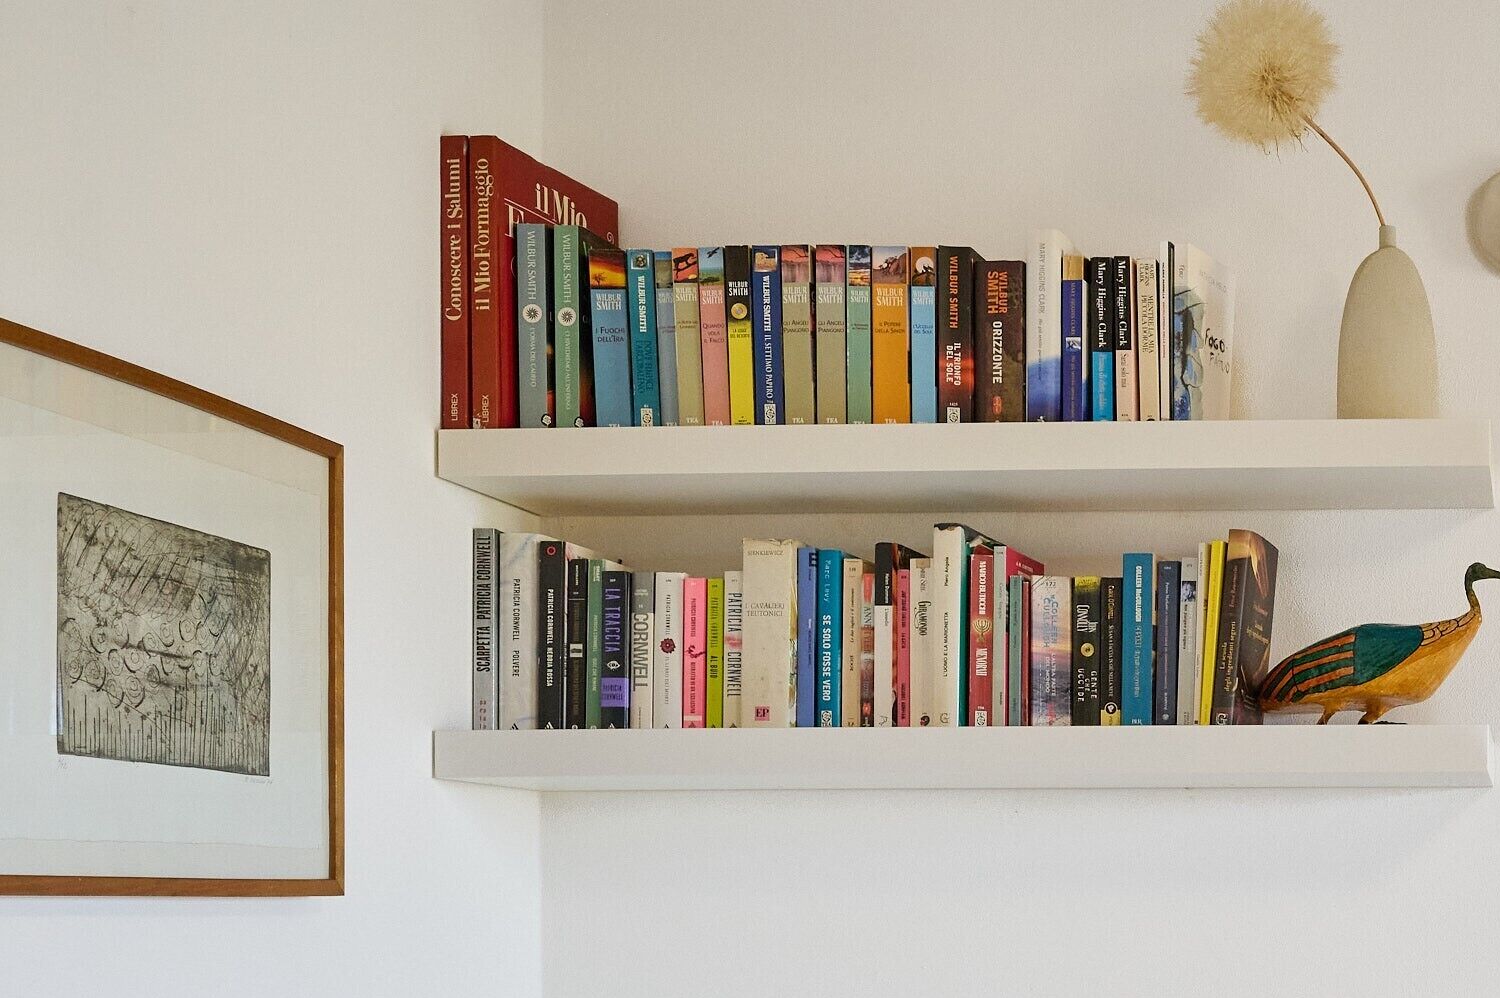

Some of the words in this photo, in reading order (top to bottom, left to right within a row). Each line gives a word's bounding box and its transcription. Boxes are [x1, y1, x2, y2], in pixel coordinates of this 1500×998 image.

[445, 158, 463, 219] Salumi
[474, 158, 495, 259] Formaggio
[535, 183, 550, 215] il
[552, 188, 588, 227] Mio
[527, 231, 536, 268] WILBUR
[561, 234, 571, 271] WILBUR
[1038, 243, 1046, 262] MARY
[445, 233, 462, 322] Conoscere
[474, 260, 491, 297] Mio
[527, 269, 536, 300] SMITH
[950, 255, 958, 293] WILBUR
[1038, 264, 1046, 292] HIGGINS
[1096, 261, 1106, 284] Mary
[1116, 260, 1126, 283] Mary
[562, 273, 571, 303] SMITH
[596, 293, 622, 301] WILBUR
[637, 275, 646, 304] WILBUR
[675, 294, 697, 302] SMITH
[702, 296, 723, 304] SMITH
[728, 287, 748, 296] SMITH
[762, 275, 770, 303] WILBUR
[783, 294, 807, 303] SMITH
[818, 294, 843, 304] SMITH
[876, 287, 904, 296] WILBUR
[876, 296, 903, 306] SMITH
[912, 297, 934, 305] SMITH
[987, 271, 998, 314] SMITH
[998, 271, 1008, 314] WILBUR
[475, 298, 491, 311] il
[596, 301, 622, 310] SMITH
[950, 297, 958, 329] SMITH
[1096, 287, 1107, 321] Higgins
[1115, 286, 1127, 319] Higgins
[638, 305, 647, 333] SMITH
[763, 303, 772, 331] SMITH
[954, 342, 961, 350] IL
[1098, 322, 1107, 348] Clark
[1118, 321, 1127, 346] Clark
[992, 321, 1002, 384] ORIZZONTE
[954, 351, 962, 386] TRIONFO
[766, 374, 774, 398] PAPIRO
[482, 394, 490, 423] LIBREX
[477, 535, 491, 581] CORNWELL
[978, 560, 987, 585] MARCO
[476, 583, 491, 621] PATRICIA
[512, 578, 521, 607] PATRICIA
[546, 588, 554, 614] PATRICIA
[605, 588, 620, 600] LA
[823, 583, 831, 602] Levy
[512, 608, 521, 641] CORNWELL
[727, 592, 742, 632] PATRICIA
[823, 614, 832, 625] SE
[914, 600, 932, 636] GIRAMONDO
[546, 615, 554, 644] CORNWELL
[605, 606, 621, 652] TRACCIA
[823, 628, 832, 649] SOLO
[476, 626, 491, 672] SCARPETTA
[633, 613, 649, 692] CORNWELL
[710, 655, 718, 663] AL
[975, 648, 988, 676] MENORAH
[1225, 643, 1235, 675] ingredienti
[512, 650, 521, 677] POLVERE
[546, 668, 554, 687] ROSSA
[727, 651, 742, 697] CORNWELL
[822, 651, 831, 677] FOSSE
[1219, 661, 1226, 670] La
[822, 679, 831, 701] VERO
[1077, 668, 1085, 702] UCCIDE
[1090, 670, 1098, 699] GENTE
[1223, 676, 1231, 692] degli
[756, 708, 769, 718] EP
